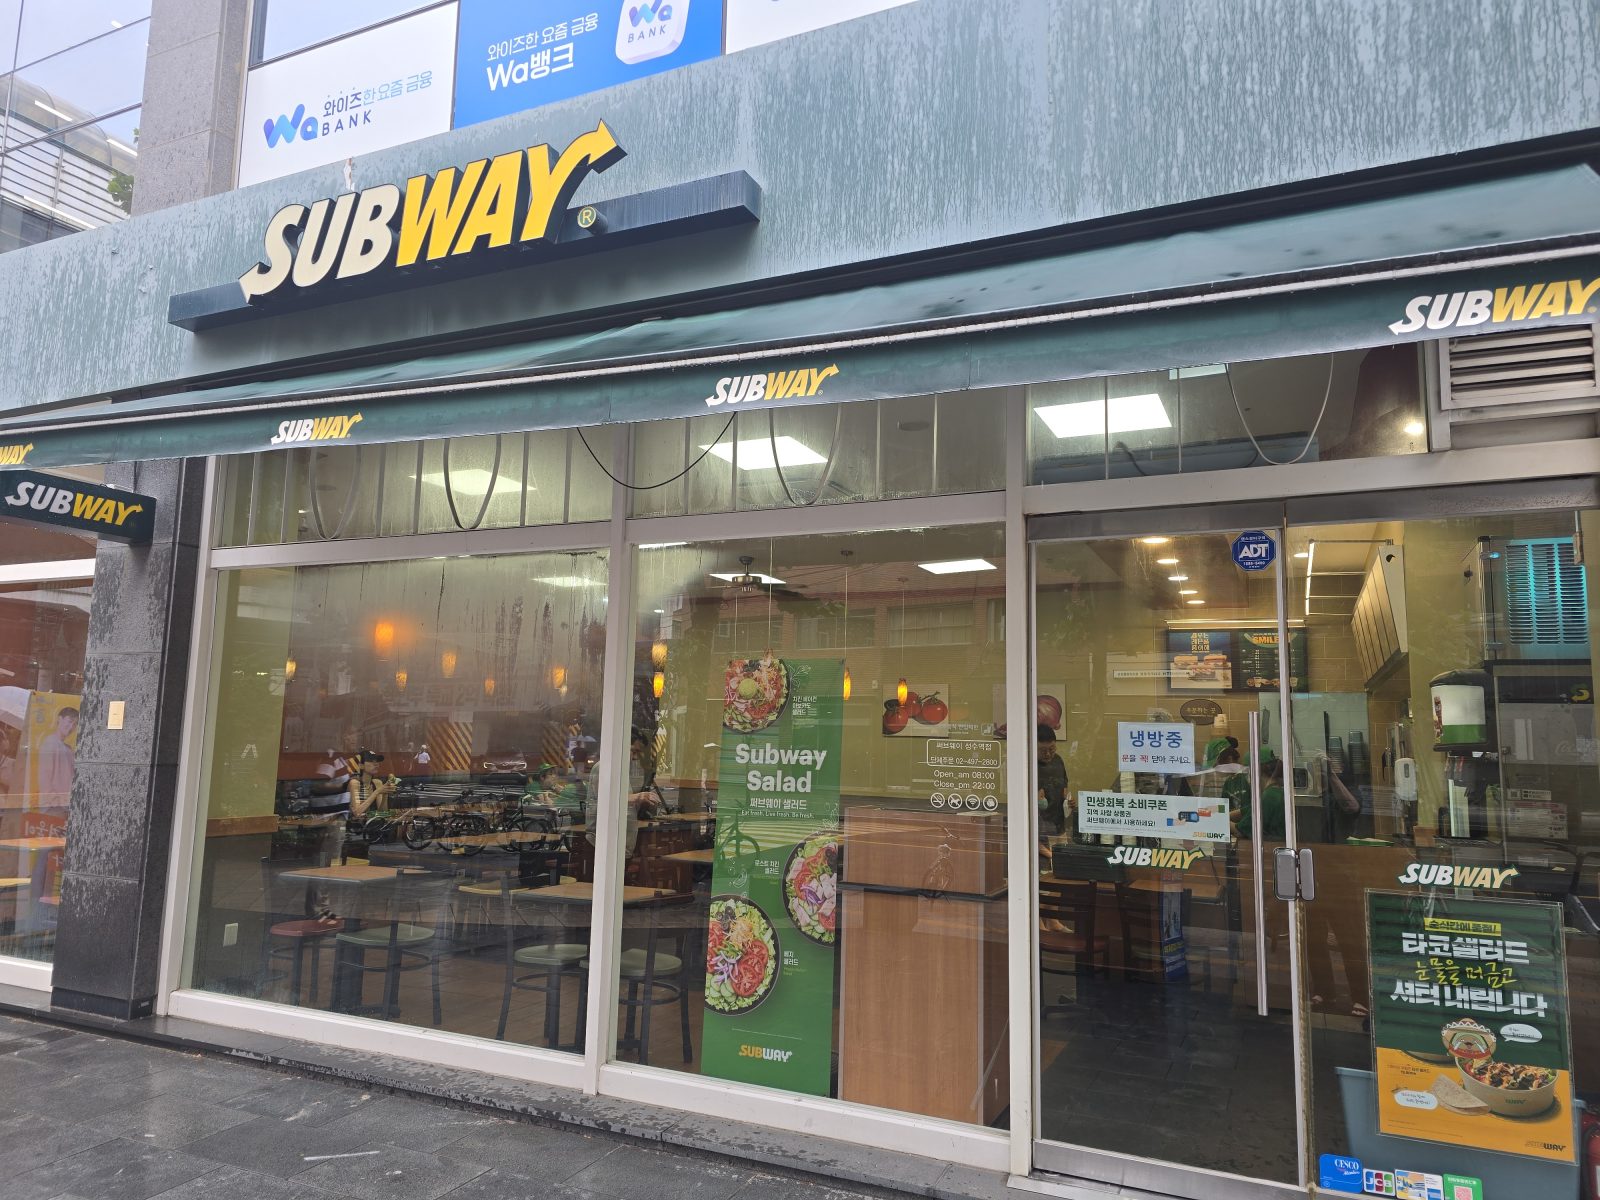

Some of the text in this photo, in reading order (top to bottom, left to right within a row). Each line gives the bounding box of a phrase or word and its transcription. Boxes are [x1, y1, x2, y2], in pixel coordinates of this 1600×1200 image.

[487, 12, 599, 61] 와이즈한 요즘 금융
[627, 25, 667, 43] BANK
[486, 42, 574, 91] Wa뱅크
[377, 79, 403, 101] 요즘
[406, 70, 433, 93] 금융
[264, 103, 318, 148] Wa
[321, 109, 372, 136] BANK
[238, 118, 622, 304] SUBWAY
[1388, 277, 1600, 336] SUBWAY
[704, 363, 839, 407] SUBWAY
[271, 412, 363, 445] SUBWAY
[5, 481, 143, 526] SUBWAY
[1239, 543, 1269, 559] ADT
[965, 743, 992, 751] 성수역점
[1130, 730, 1182, 748] 냉방중
[735, 743, 827, 770] Subway
[955, 757, 997, 766] 02-497-2800
[1122, 754, 1136, 762] 문을
[1152, 755, 1166, 763] 닫아
[747, 770, 811, 792] Salad
[972, 771, 994, 779] 08:00
[972, 781, 996, 790] 22:00
[750, 797, 807, 810] 써브웨이 샐러드
[1086, 796, 1168, 811] 민생회복 소비쿠폰
[1114, 810, 1131, 818] 상품권
[1106, 846, 1204, 870] SUBWAY
[1398, 863, 1519, 889] SUBWAY
[1416, 958, 1462, 986] 눈물을
[1391, 979, 1548, 1018] 셔터 내립니다
[738, 1045, 793, 1063] SUBWAY
[1334, 1158, 1360, 1170] CESCO
